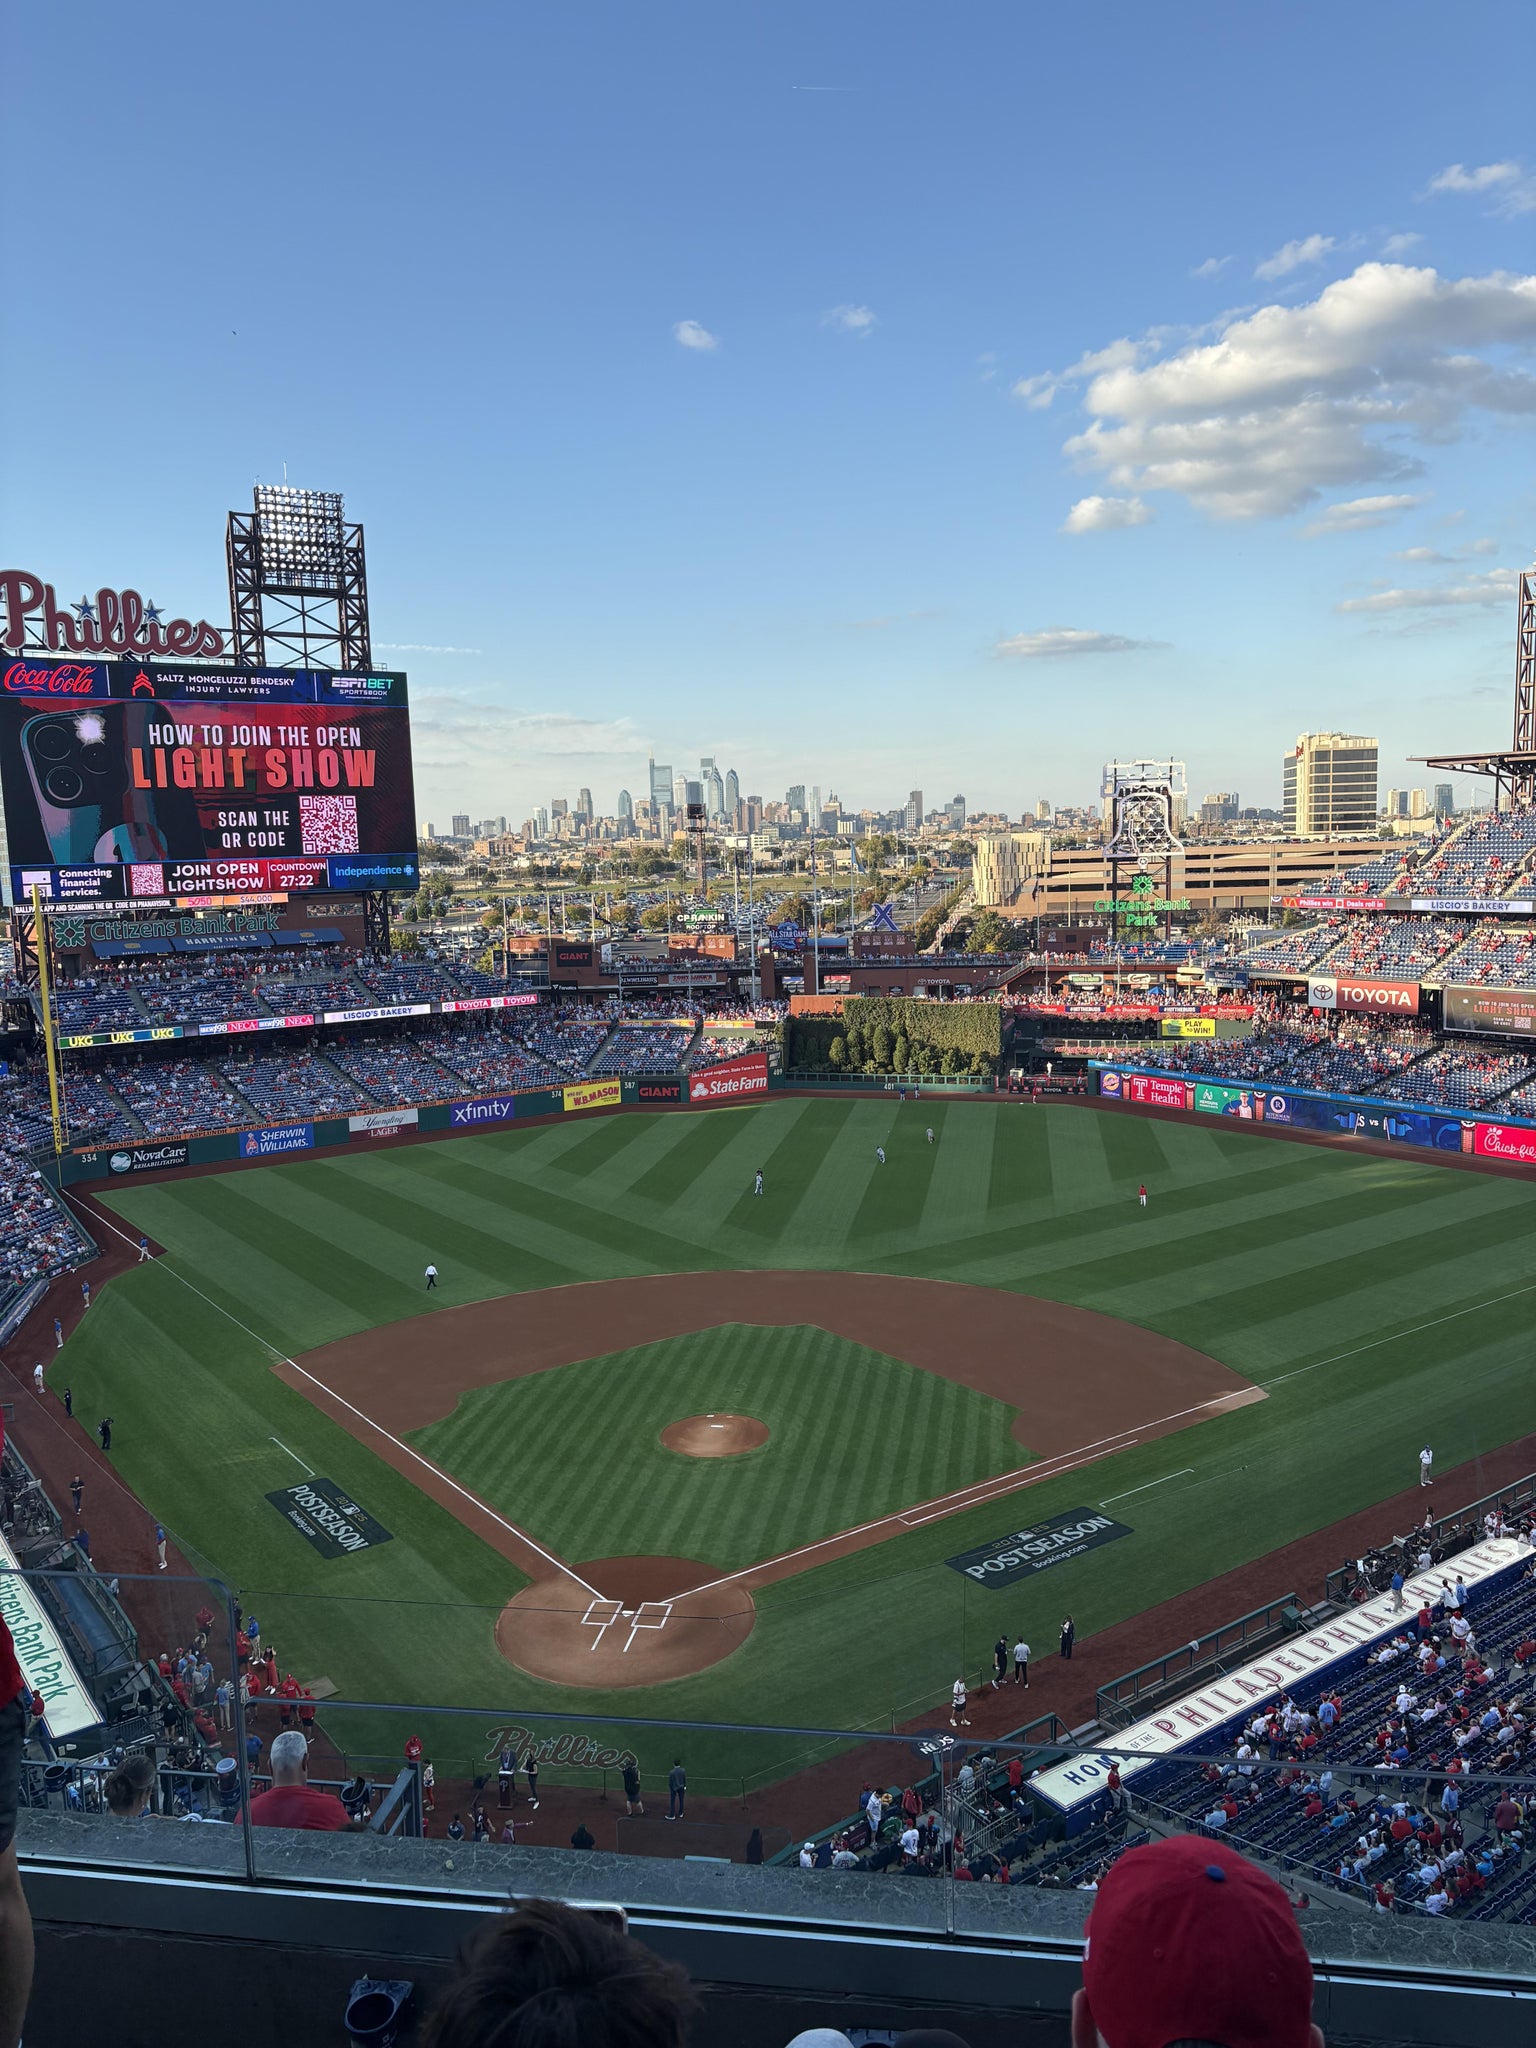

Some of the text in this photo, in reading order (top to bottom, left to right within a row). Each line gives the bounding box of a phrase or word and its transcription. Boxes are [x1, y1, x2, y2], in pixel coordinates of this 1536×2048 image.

[0, 568, 225, 657] Phillies
[3, 662, 97, 694] Coca-Cola
[157, 673, 295, 687] SALTZ MONGELUZZI BENDESKY
[185, 685, 271, 695] INJURY LAWYERS
[149, 724, 361, 748] HOW TO JOIN THE OPEN
[131, 748, 376, 789] LIGHT SHOW
[218, 810, 290, 827] SCAN THE
[222, 831, 286, 849] QR CODE
[59, 869, 112, 880] Connecting
[172, 862, 259, 877] JOIN OPEN
[270, 863, 326, 872] COUNTDOWN
[335, 865, 402, 878] Independence
[59, 879, 101, 888] financial
[168, 877, 264, 892] LIGHTSHOW
[280, 874, 314, 888] 27:22
[60, 889, 102, 898] services.
[15, 905, 43, 914] BALLPAK
[56, 904, 67, 912] AND
[68, 903, 95, 911] SCANNING
[1094, 896, 1191, 913] Citizens Bank
[1299, 899, 1321, 907] Phillies
[1346, 900, 1364, 908] Deals
[1364, 900, 1376, 908] roll
[1377, 900, 1384, 908] in
[1431, 901, 1511, 911] LISCIO'S BAKERY
[1126, 912, 1158, 926] Park
[90, 913, 280, 941] Citizens Bank Park
[185, 935, 224, 946] HARRY
[457, 996, 536, 1009] TOYOTA TOYOTA
[1341, 987, 1412, 1007] TOYOTA
[343, 1007, 413, 1020] LISCIO'S BAKERY
[1473, 1004, 1503, 1014] LIGHT
[1184, 1020, 1203, 1028] PLAY
[69, 1028, 175, 1048] UKG UKG UKG
[624, 1081, 636, 1089] 387
[639, 1087, 680, 1096] GIANT
[1150, 1079, 1183, 1095] Temple
[551, 1090, 562, 1098] 374
[1150, 1091, 1181, 1106] Health
[363, 1106, 397, 1115] ASPLUNDH
[404, 1101, 437, 1110] ASPLUNDH
[455, 1100, 511, 1122] xfinity
[278, 1117, 315, 1126] ASPLUNDH
[322, 1112, 356, 1120] ASPLUNDH
[362, 1113, 406, 1128] Yuengling
[189, 1129, 228, 1138] ASPLUNDH
[234, 1123, 272, 1132] ASPLUNDH
[260, 1127, 306, 1142] SHERWIN
[370, 1127, 399, 1137] LAGER
[93, 1141, 135, 1151] ASPLUNDH
[142, 1135, 182, 1144] ASPLUNDH
[259, 1137, 308, 1152] WILLIAMS.
[1484, 1127, 1536, 1159] Chick-fil
[81, 1153, 97, 1163] 334
[132, 1147, 187, 1163] NovaCare
[133, 1157, 185, 1170] REHABILITATION
[286, 1484, 369, 1551] POSTSEASON
[287, 1510, 317, 1537] Booking.com
[964, 1516, 1114, 1580] POSTSEASON
[1032, 1543, 1088, 1569] Booking.com
[11, 1621, 75, 1702] Bank Park
[1130, 1737, 1143, 1749] OF
[1140, 1733, 1156, 1744] THE
[1150, 1610, 1394, 1740] PHILADELPHIA
[484, 1726, 638, 1771] Phillies
